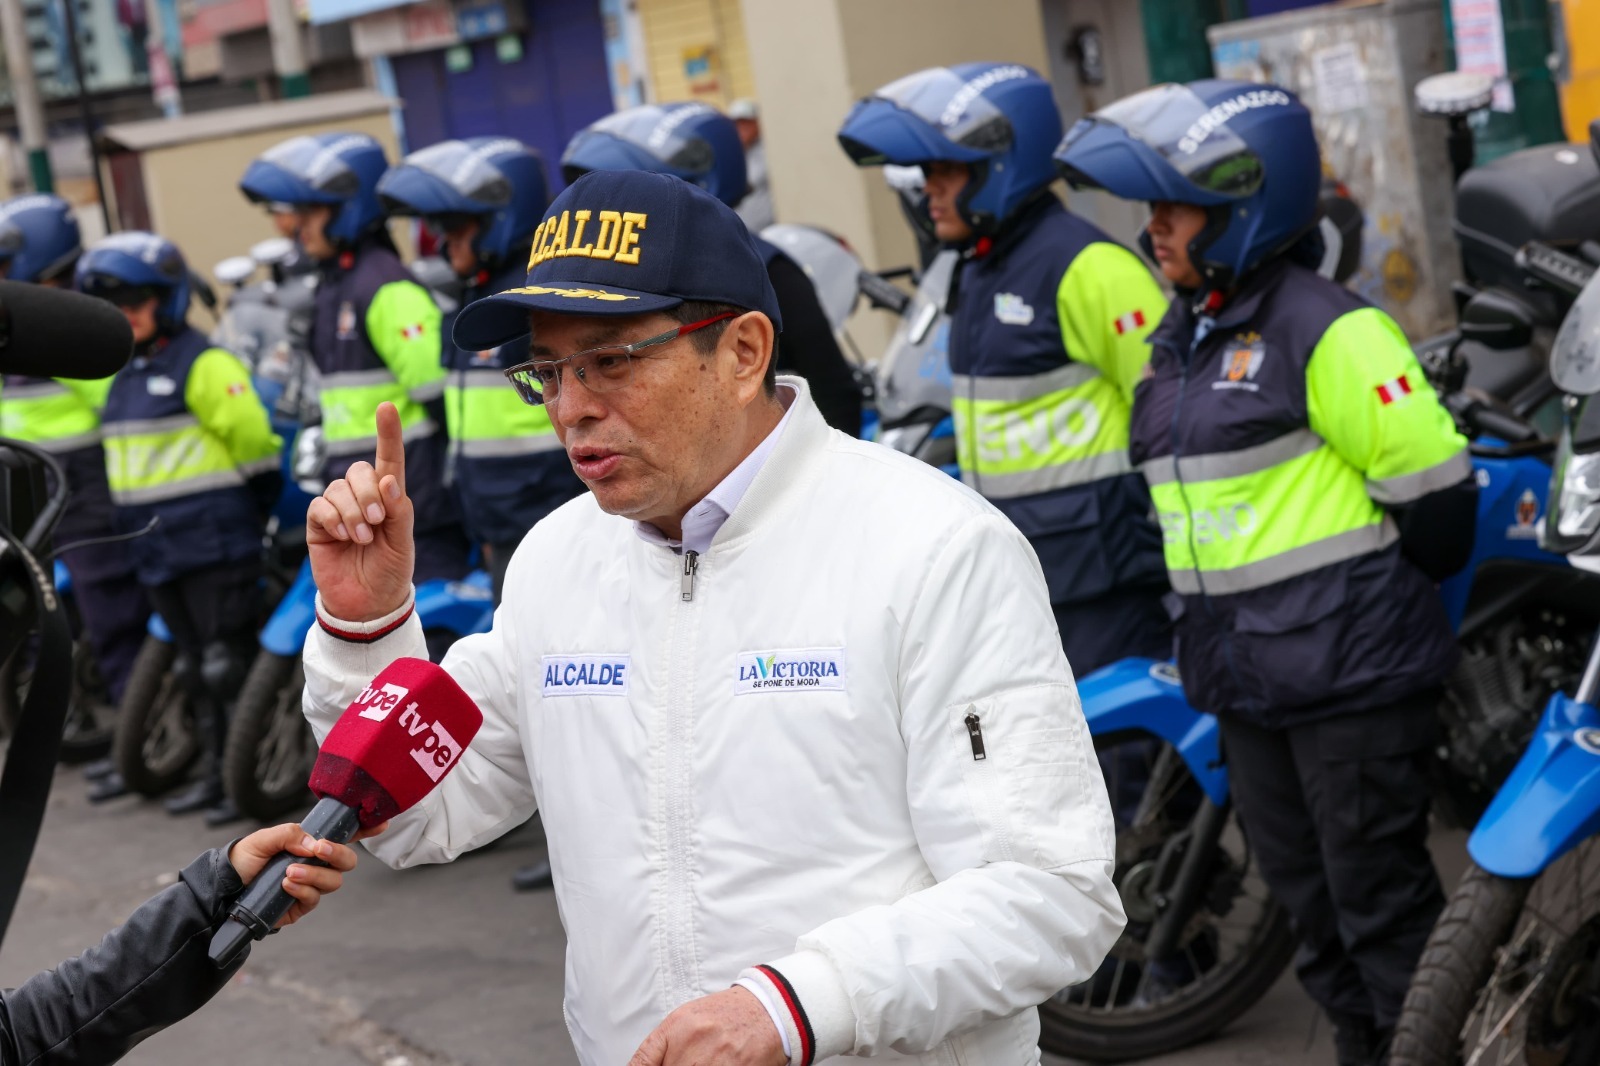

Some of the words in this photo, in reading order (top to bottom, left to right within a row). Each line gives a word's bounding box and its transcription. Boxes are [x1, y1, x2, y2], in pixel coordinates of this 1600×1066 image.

[1178, 90, 1289, 154] SERENAZGO
[545, 663, 625, 688] ALCALDE
[797, 678, 820, 686] MODA
[399, 702, 454, 768] tvpe
